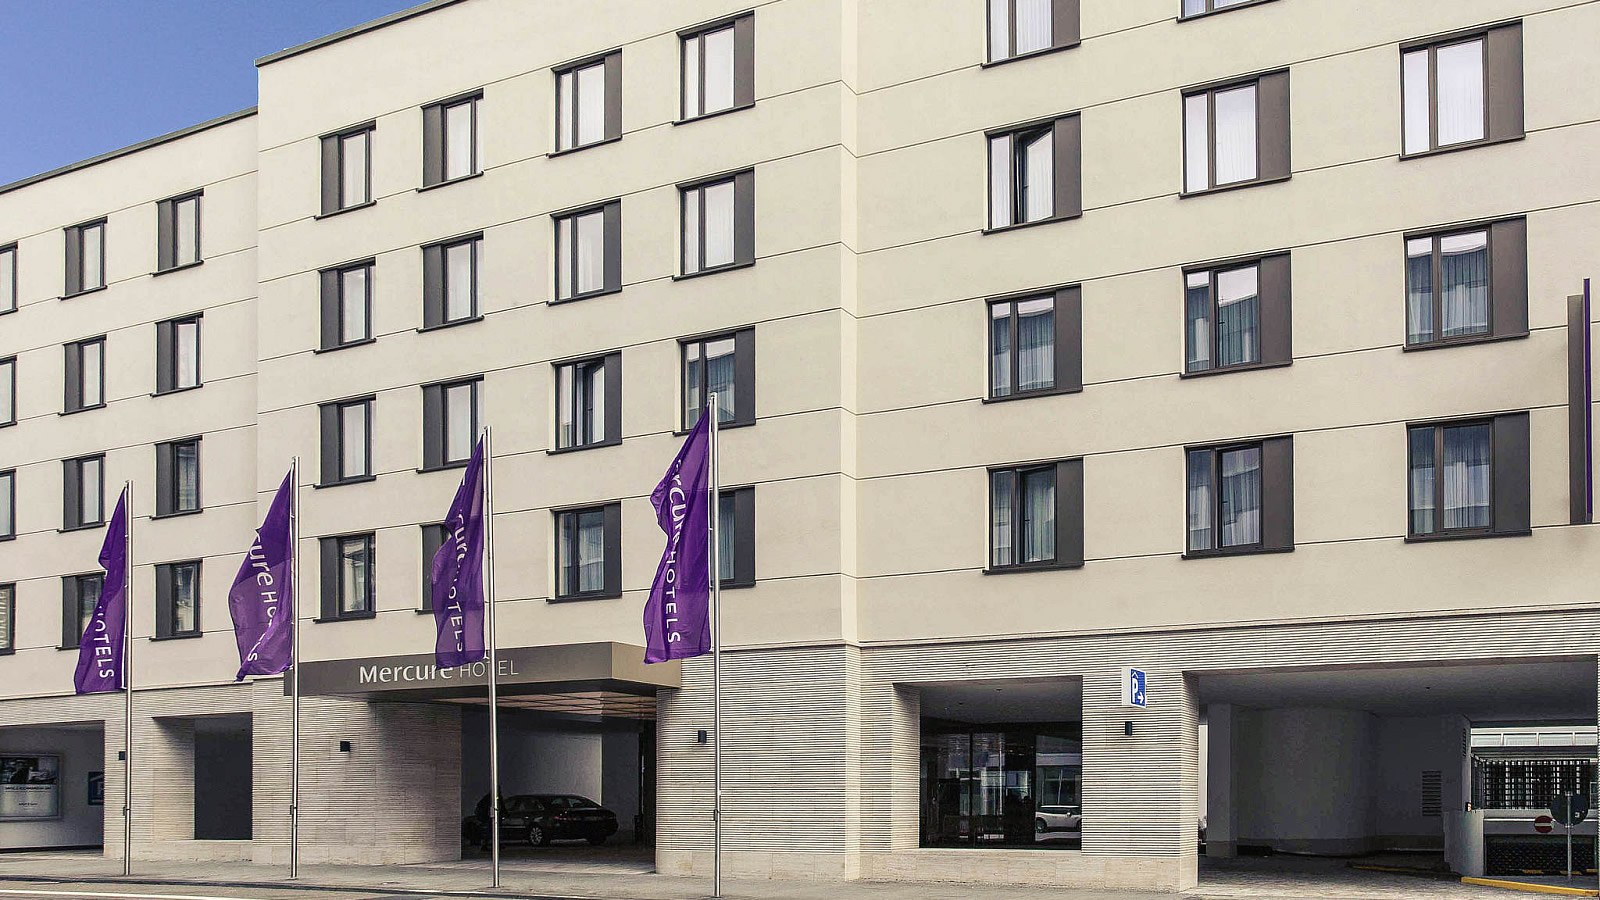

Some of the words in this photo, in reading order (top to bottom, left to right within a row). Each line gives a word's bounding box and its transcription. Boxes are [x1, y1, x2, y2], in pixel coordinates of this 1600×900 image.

[447, 577, 463, 652] OTELS
[665, 550, 681, 643] HOTELS
[93, 605, 115, 678] OTELS
[359, 664, 453, 684] Mercure
[459, 659, 519, 679] HOEL
